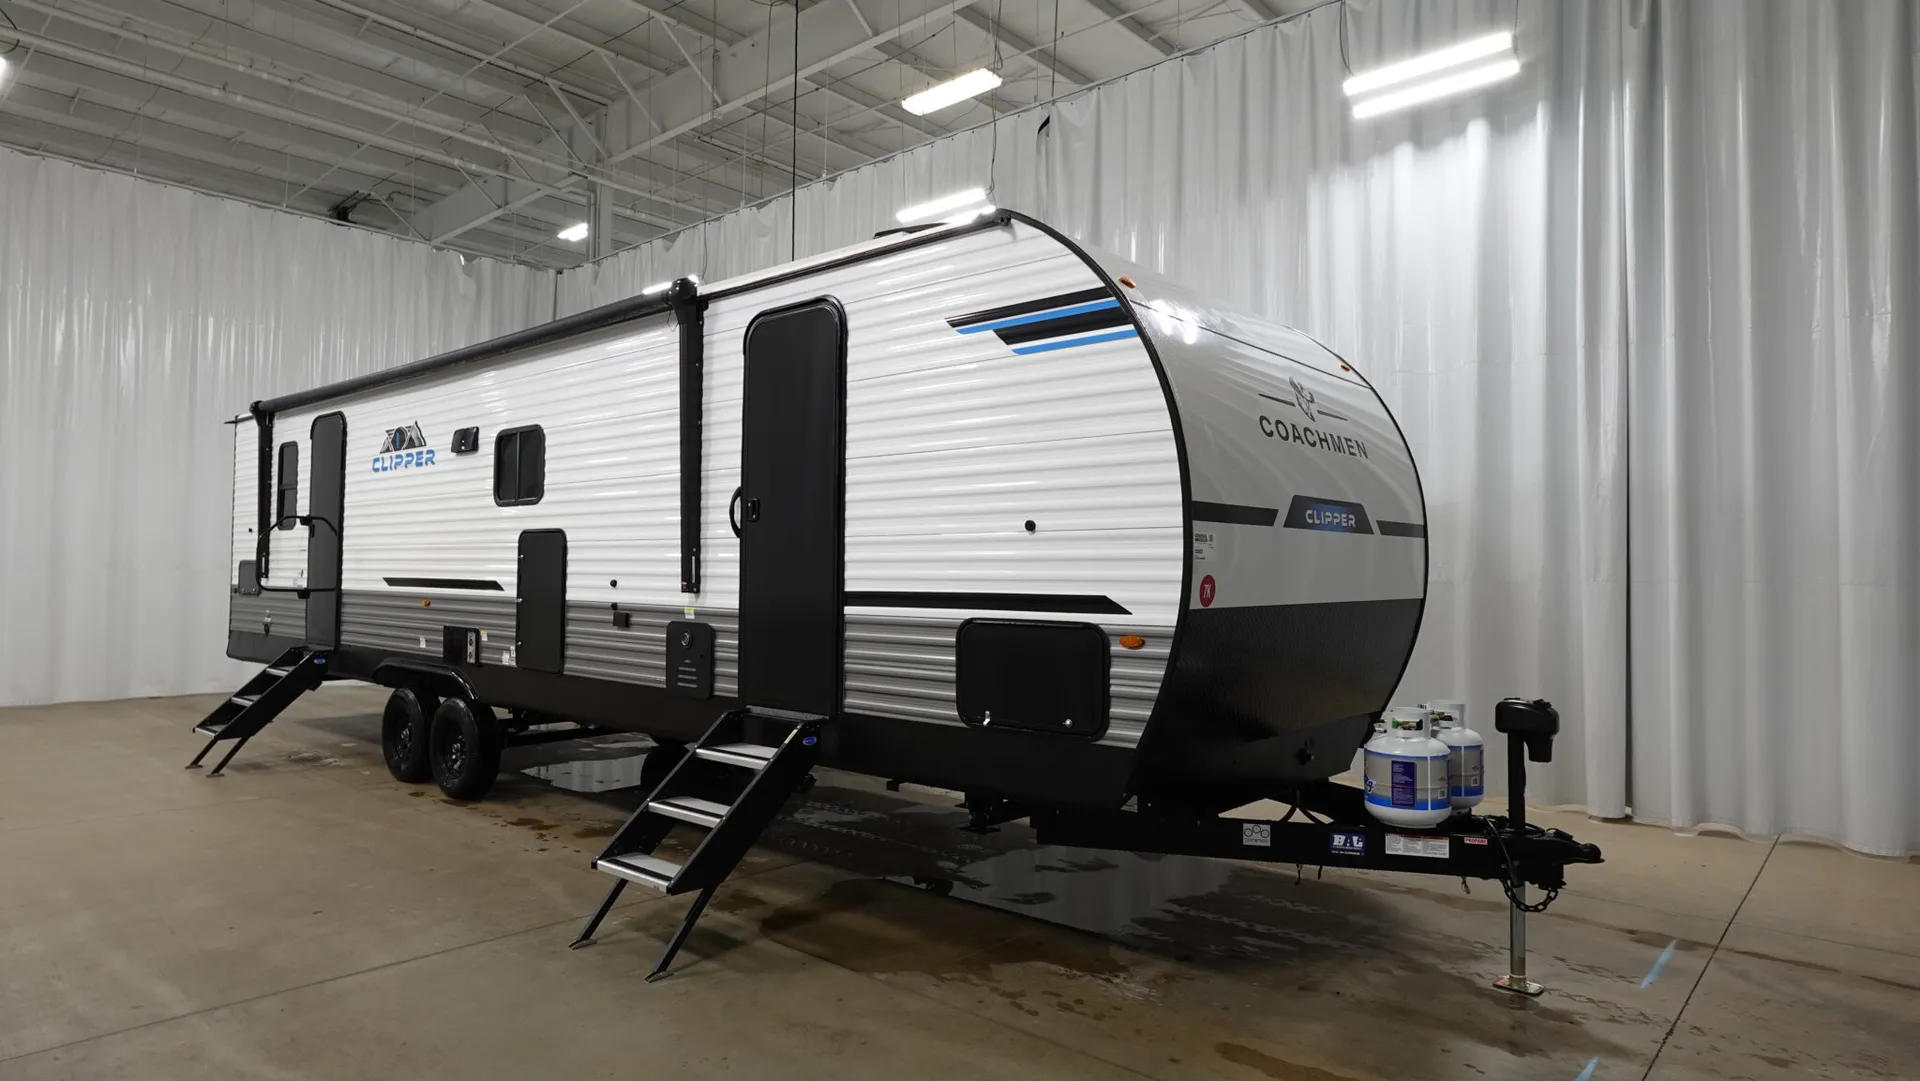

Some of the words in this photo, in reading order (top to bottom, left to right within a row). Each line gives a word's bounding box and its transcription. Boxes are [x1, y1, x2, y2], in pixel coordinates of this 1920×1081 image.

[1259, 415, 1369, 459] COACHMEN
[372, 449, 436, 472] CLIPPER
[1305, 509, 1356, 527] CLIPPER
[1333, 834, 1364, 848] BAL
